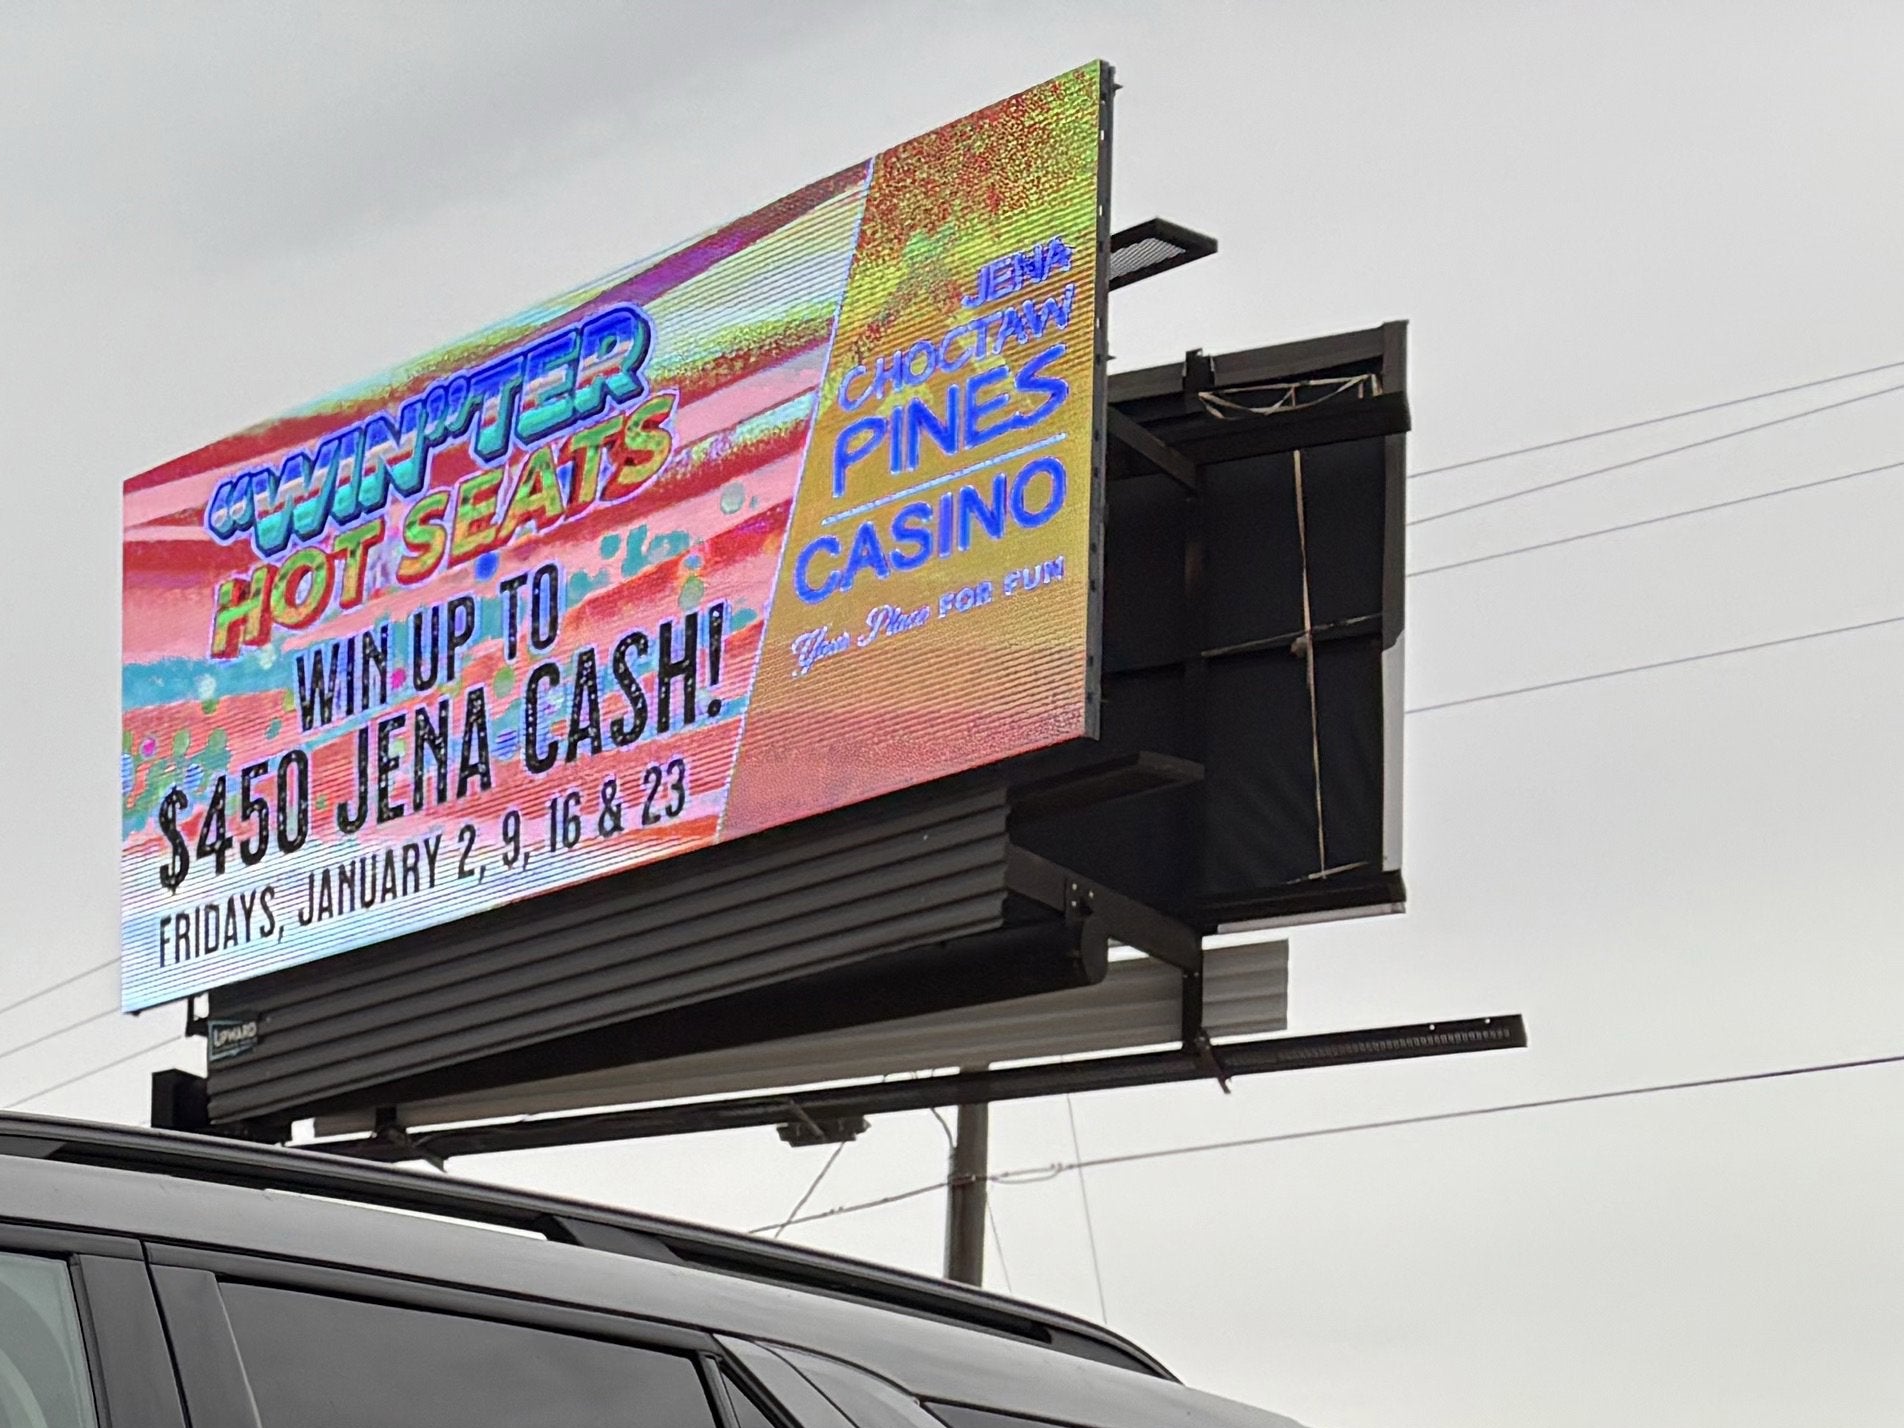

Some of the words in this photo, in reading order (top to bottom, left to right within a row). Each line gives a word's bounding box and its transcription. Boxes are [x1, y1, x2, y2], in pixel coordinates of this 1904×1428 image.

[838, 283, 1076, 411] CHOCTAW
[962, 235, 1074, 308] JENA
[832, 343, 1069, 499] PINES
[209, 516, 387, 661] HOT
[394, 391, 680, 586] SEATS
[793, 455, 1067, 604] CASINO
[938, 581, 993, 619] FOR
[1003, 555, 1065, 597] FUN
[294, 624, 390, 733] WIN
[412, 595, 476, 692] UP
[499, 563, 560, 661] TO
[157, 748, 310, 894] $450
[335, 687, 493, 836] JENA
[524, 601, 725, 774] CASH!
[158, 886, 287, 969] FRIDAYS,
[298, 832, 444, 928] JANUARY
[457, 824, 487, 886] 2,
[501, 809, 530, 873] 9,
[548, 790, 582, 855] 16
[597, 779, 626, 838] &
[641, 757, 688, 827] 23
